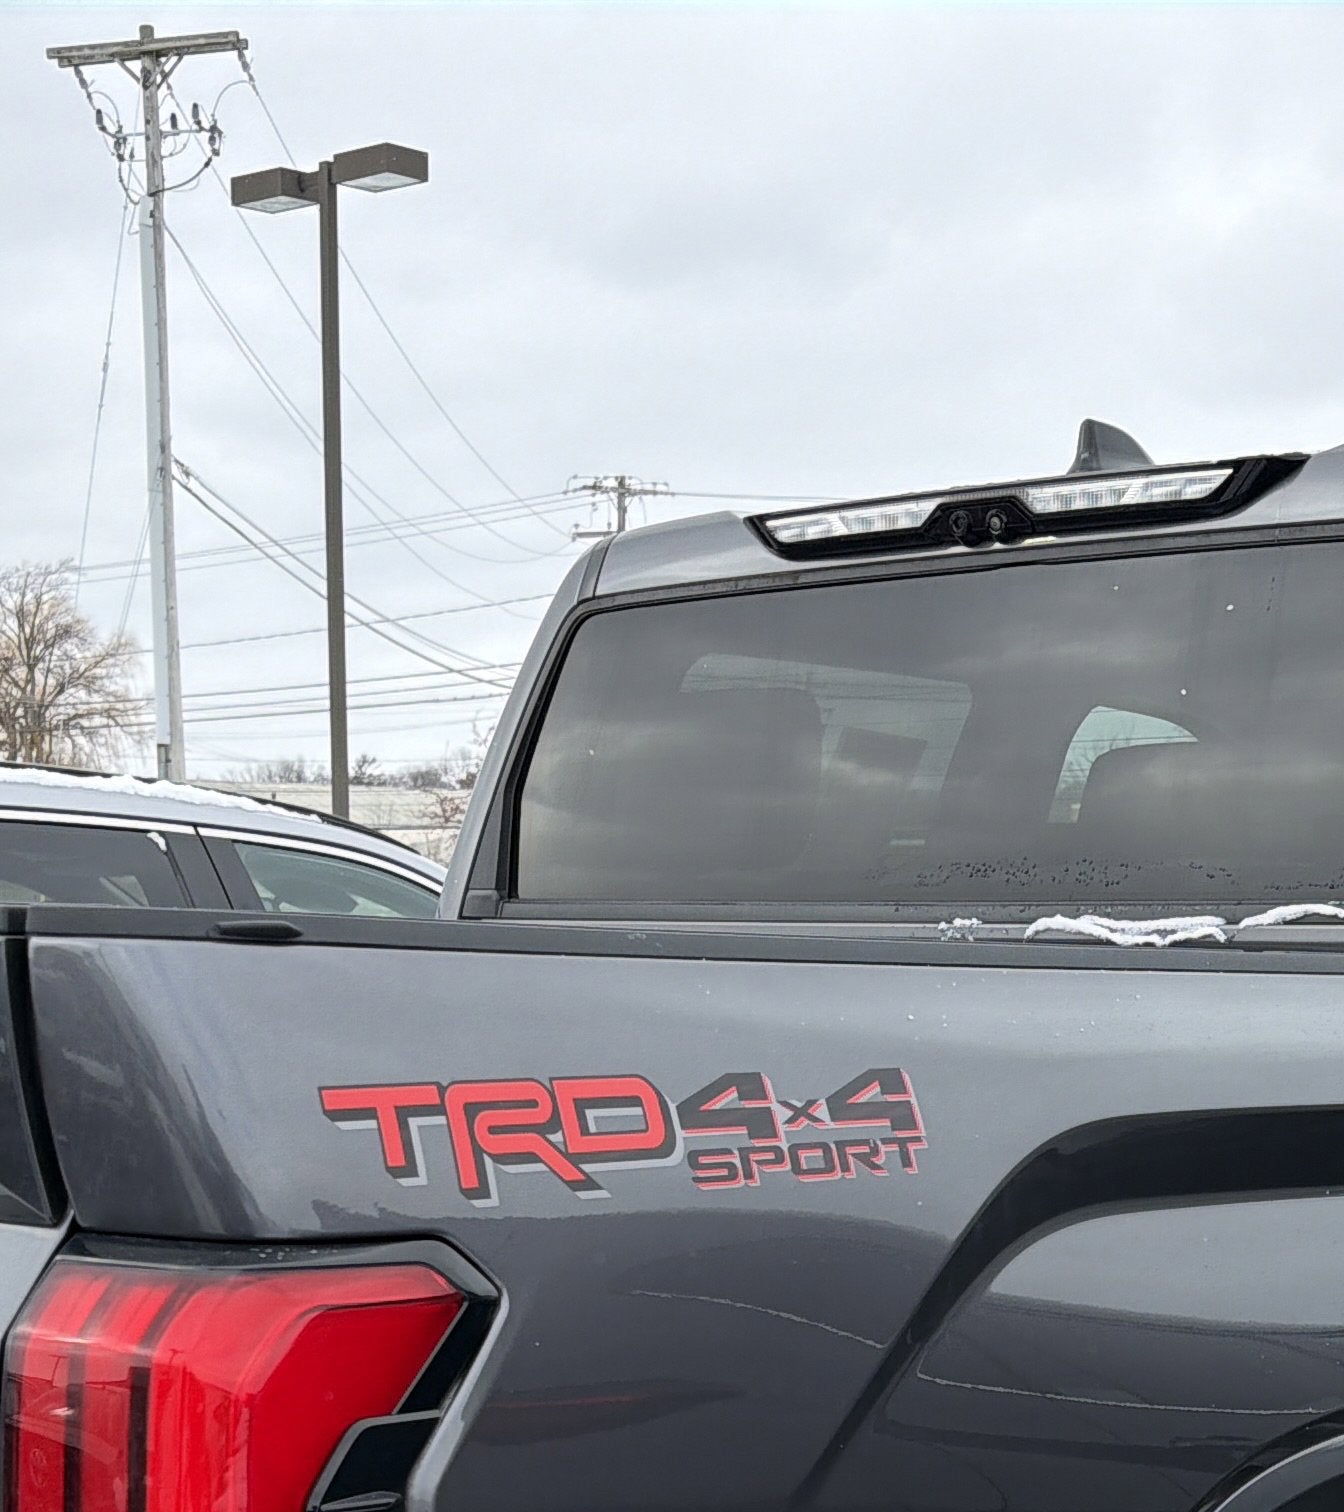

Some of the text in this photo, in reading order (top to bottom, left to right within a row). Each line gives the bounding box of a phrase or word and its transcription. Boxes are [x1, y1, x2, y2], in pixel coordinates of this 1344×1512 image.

[318, 1067, 926, 1207] TRD 4x4
[685, 1135, 928, 1191] SPORT
